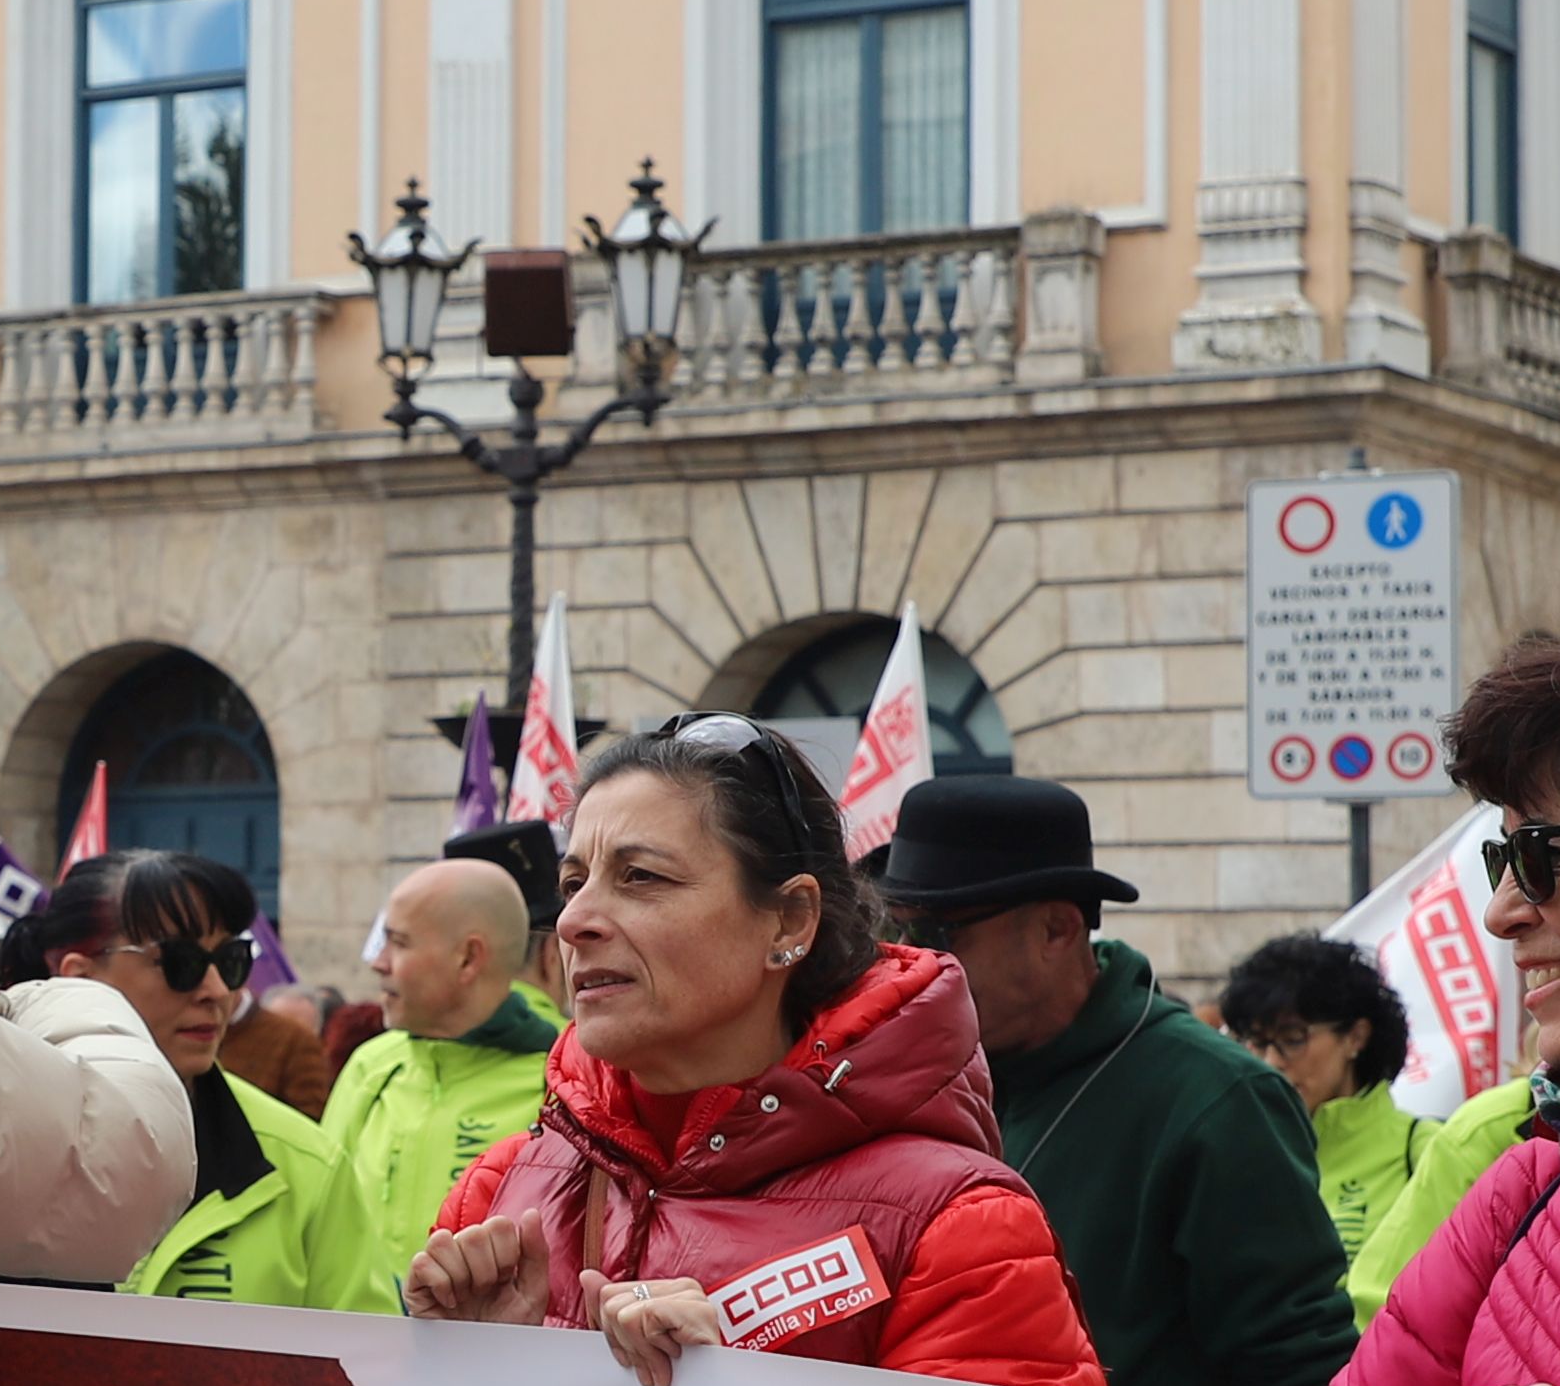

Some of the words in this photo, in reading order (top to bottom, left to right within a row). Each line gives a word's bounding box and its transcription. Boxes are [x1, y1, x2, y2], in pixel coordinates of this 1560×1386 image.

[1270, 585, 1349, 600] VECINOS
[1256, 610, 1316, 625] CARGA
[1347, 606, 1446, 622] DESCARGA
[1292, 628, 1410, 643] LABORABLES
[1265, 649, 1288, 664] DE
[1276, 669, 1297, 684] DE
[1265, 710, 1288, 725] DE
[1415, 898, 1493, 1036] CCOO
[722, 1251, 849, 1327] CCOO
[806, 1306, 817, 1326] y
[819, 1287, 874, 1317] León
